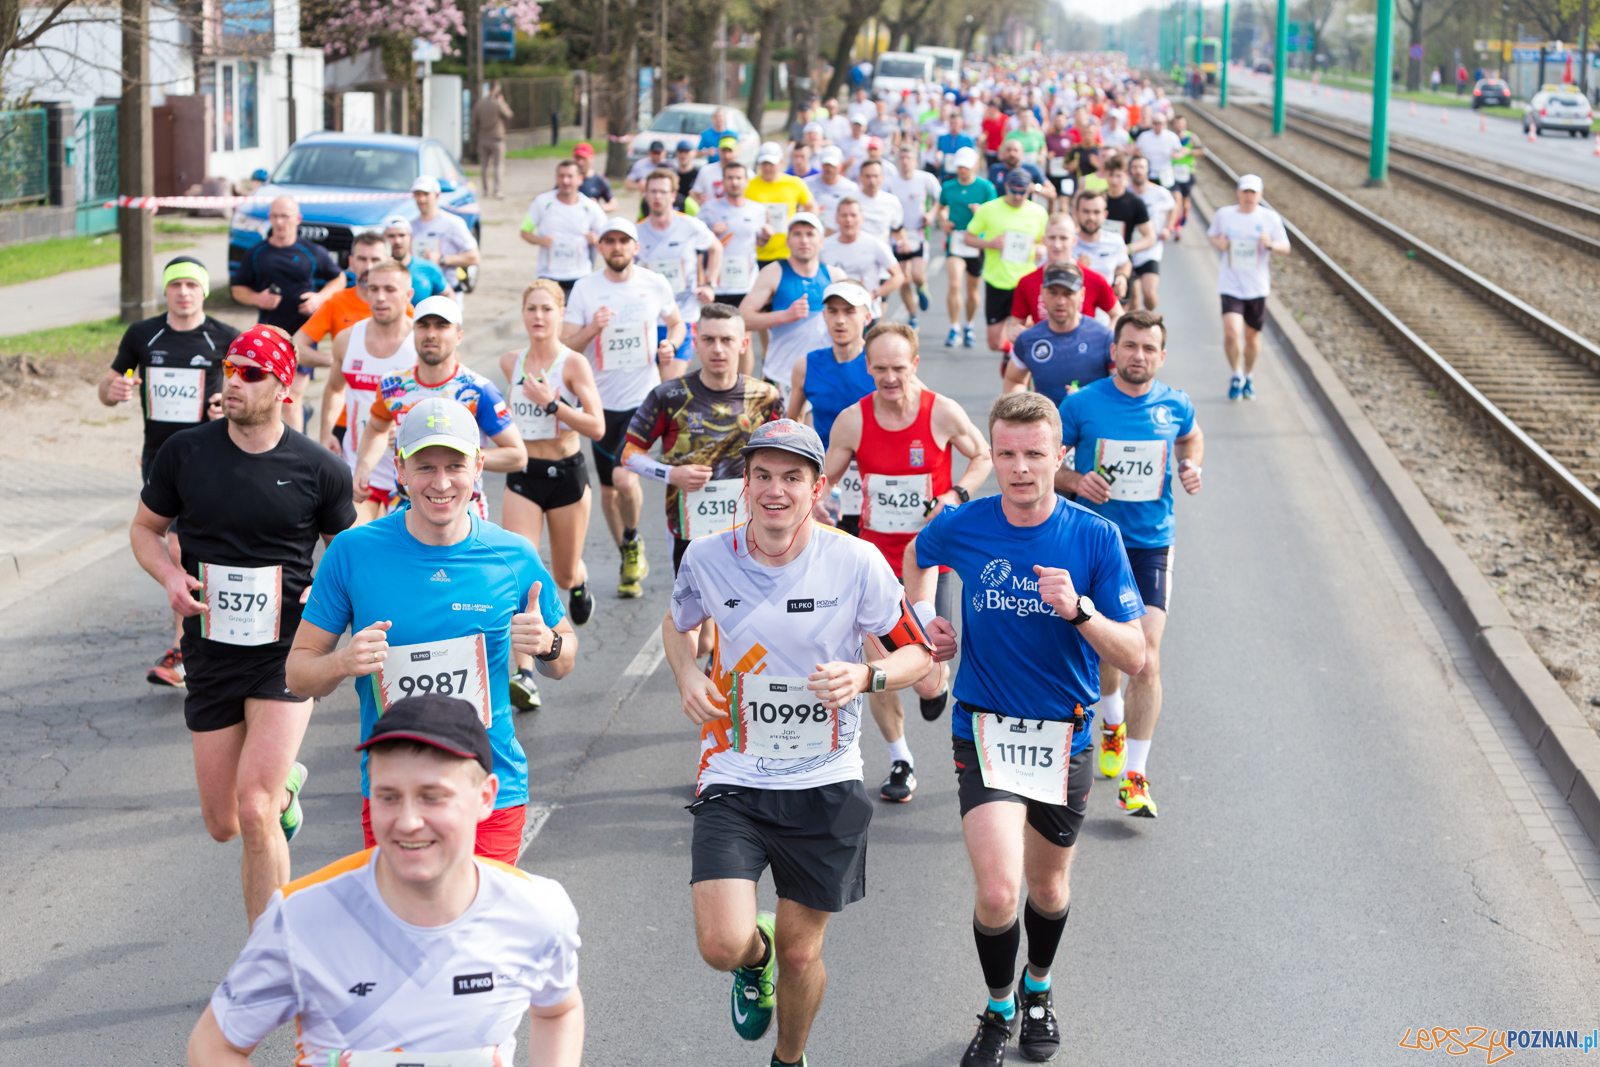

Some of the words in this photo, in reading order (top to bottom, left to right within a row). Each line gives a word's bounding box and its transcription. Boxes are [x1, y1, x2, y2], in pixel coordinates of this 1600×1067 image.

[608, 336, 641, 350] 2393
[355, 374, 380, 384] POLS
[152, 384, 197, 398] 10942
[513, 402, 546, 417] 1016
[1114, 460, 1153, 476] 4716
[843, 477, 862, 492] 96
[697, 499, 737, 515] 6318
[878, 493, 921, 508] 5428
[217, 590, 268, 612] 5379
[724, 598, 741, 608] 4F
[398, 669, 468, 698] 9987
[748, 701, 828, 724] 10998
[996, 743, 1053, 768] 11113
[348, 982, 377, 996] 4F
